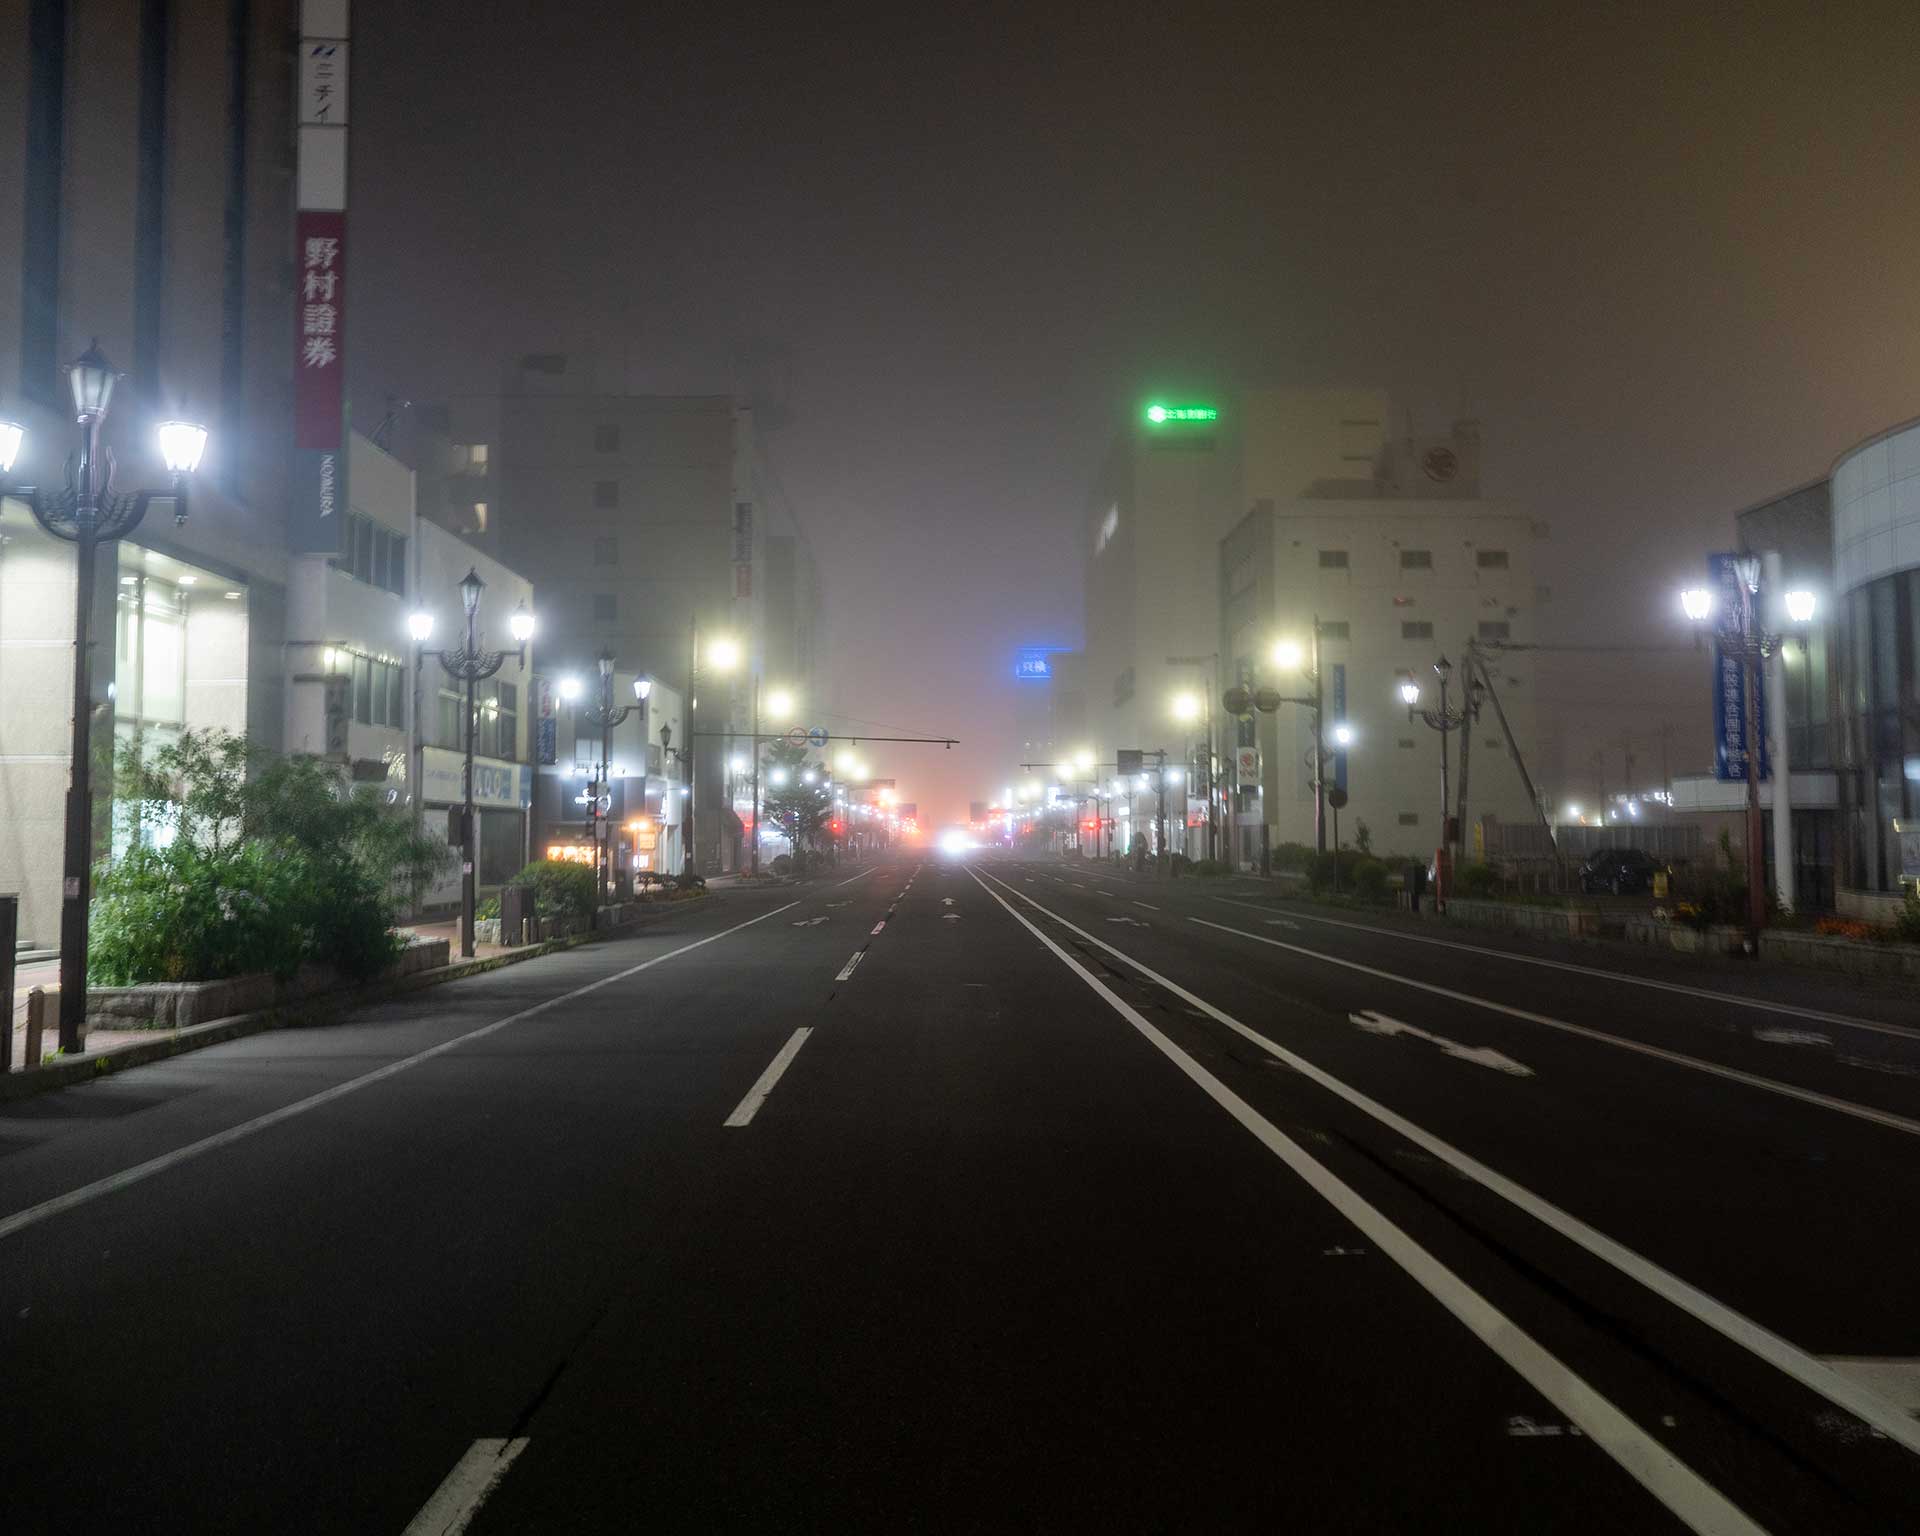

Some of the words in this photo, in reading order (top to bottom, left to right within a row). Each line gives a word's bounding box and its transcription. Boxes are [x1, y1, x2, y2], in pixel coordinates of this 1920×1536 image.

[302, 237, 339, 369] 野村證券
[319, 454, 335, 518] NOMURA
